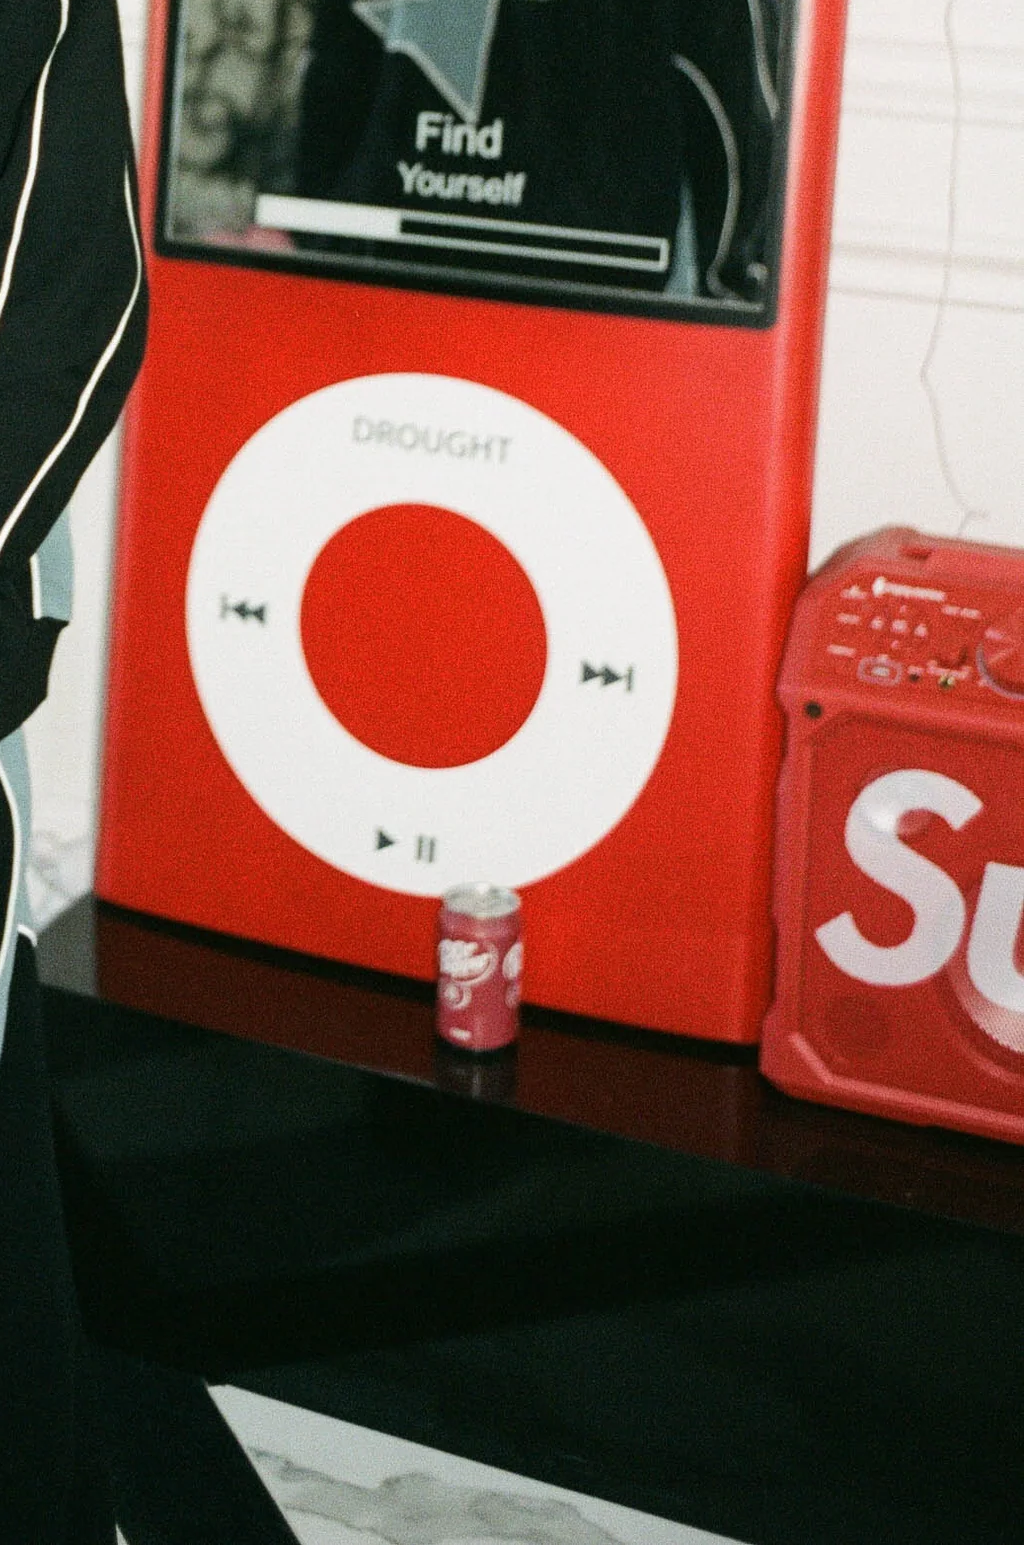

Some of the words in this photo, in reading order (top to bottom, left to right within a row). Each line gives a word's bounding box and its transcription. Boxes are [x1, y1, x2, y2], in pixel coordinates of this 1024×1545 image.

[414, 111, 504, 159] Find
[397, 160, 526, 206] Yourself
[352, 416, 513, 464] DROUGHT
